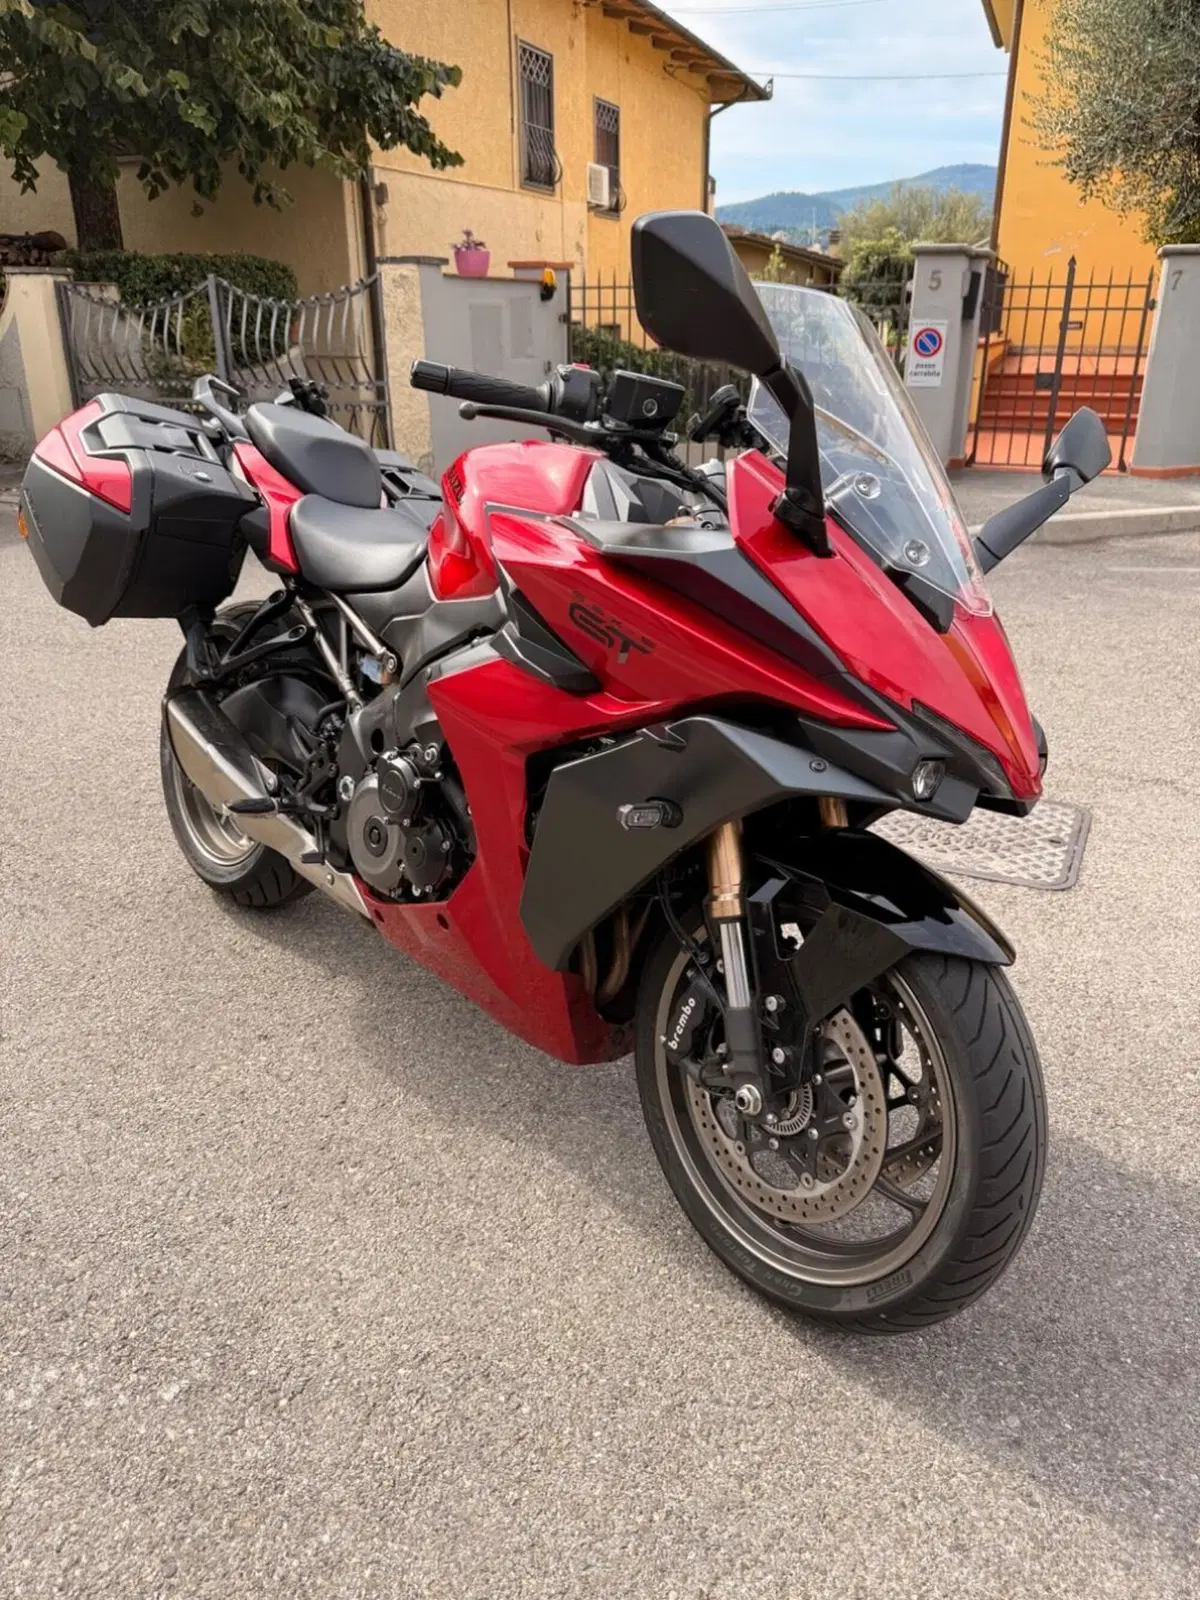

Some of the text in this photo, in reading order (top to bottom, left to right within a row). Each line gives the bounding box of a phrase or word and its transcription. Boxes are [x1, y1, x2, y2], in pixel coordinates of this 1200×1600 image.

[928, 269, 942, 292] 5
[1171, 269, 1183, 291] 7
[667, 997, 696, 1050] brembo
